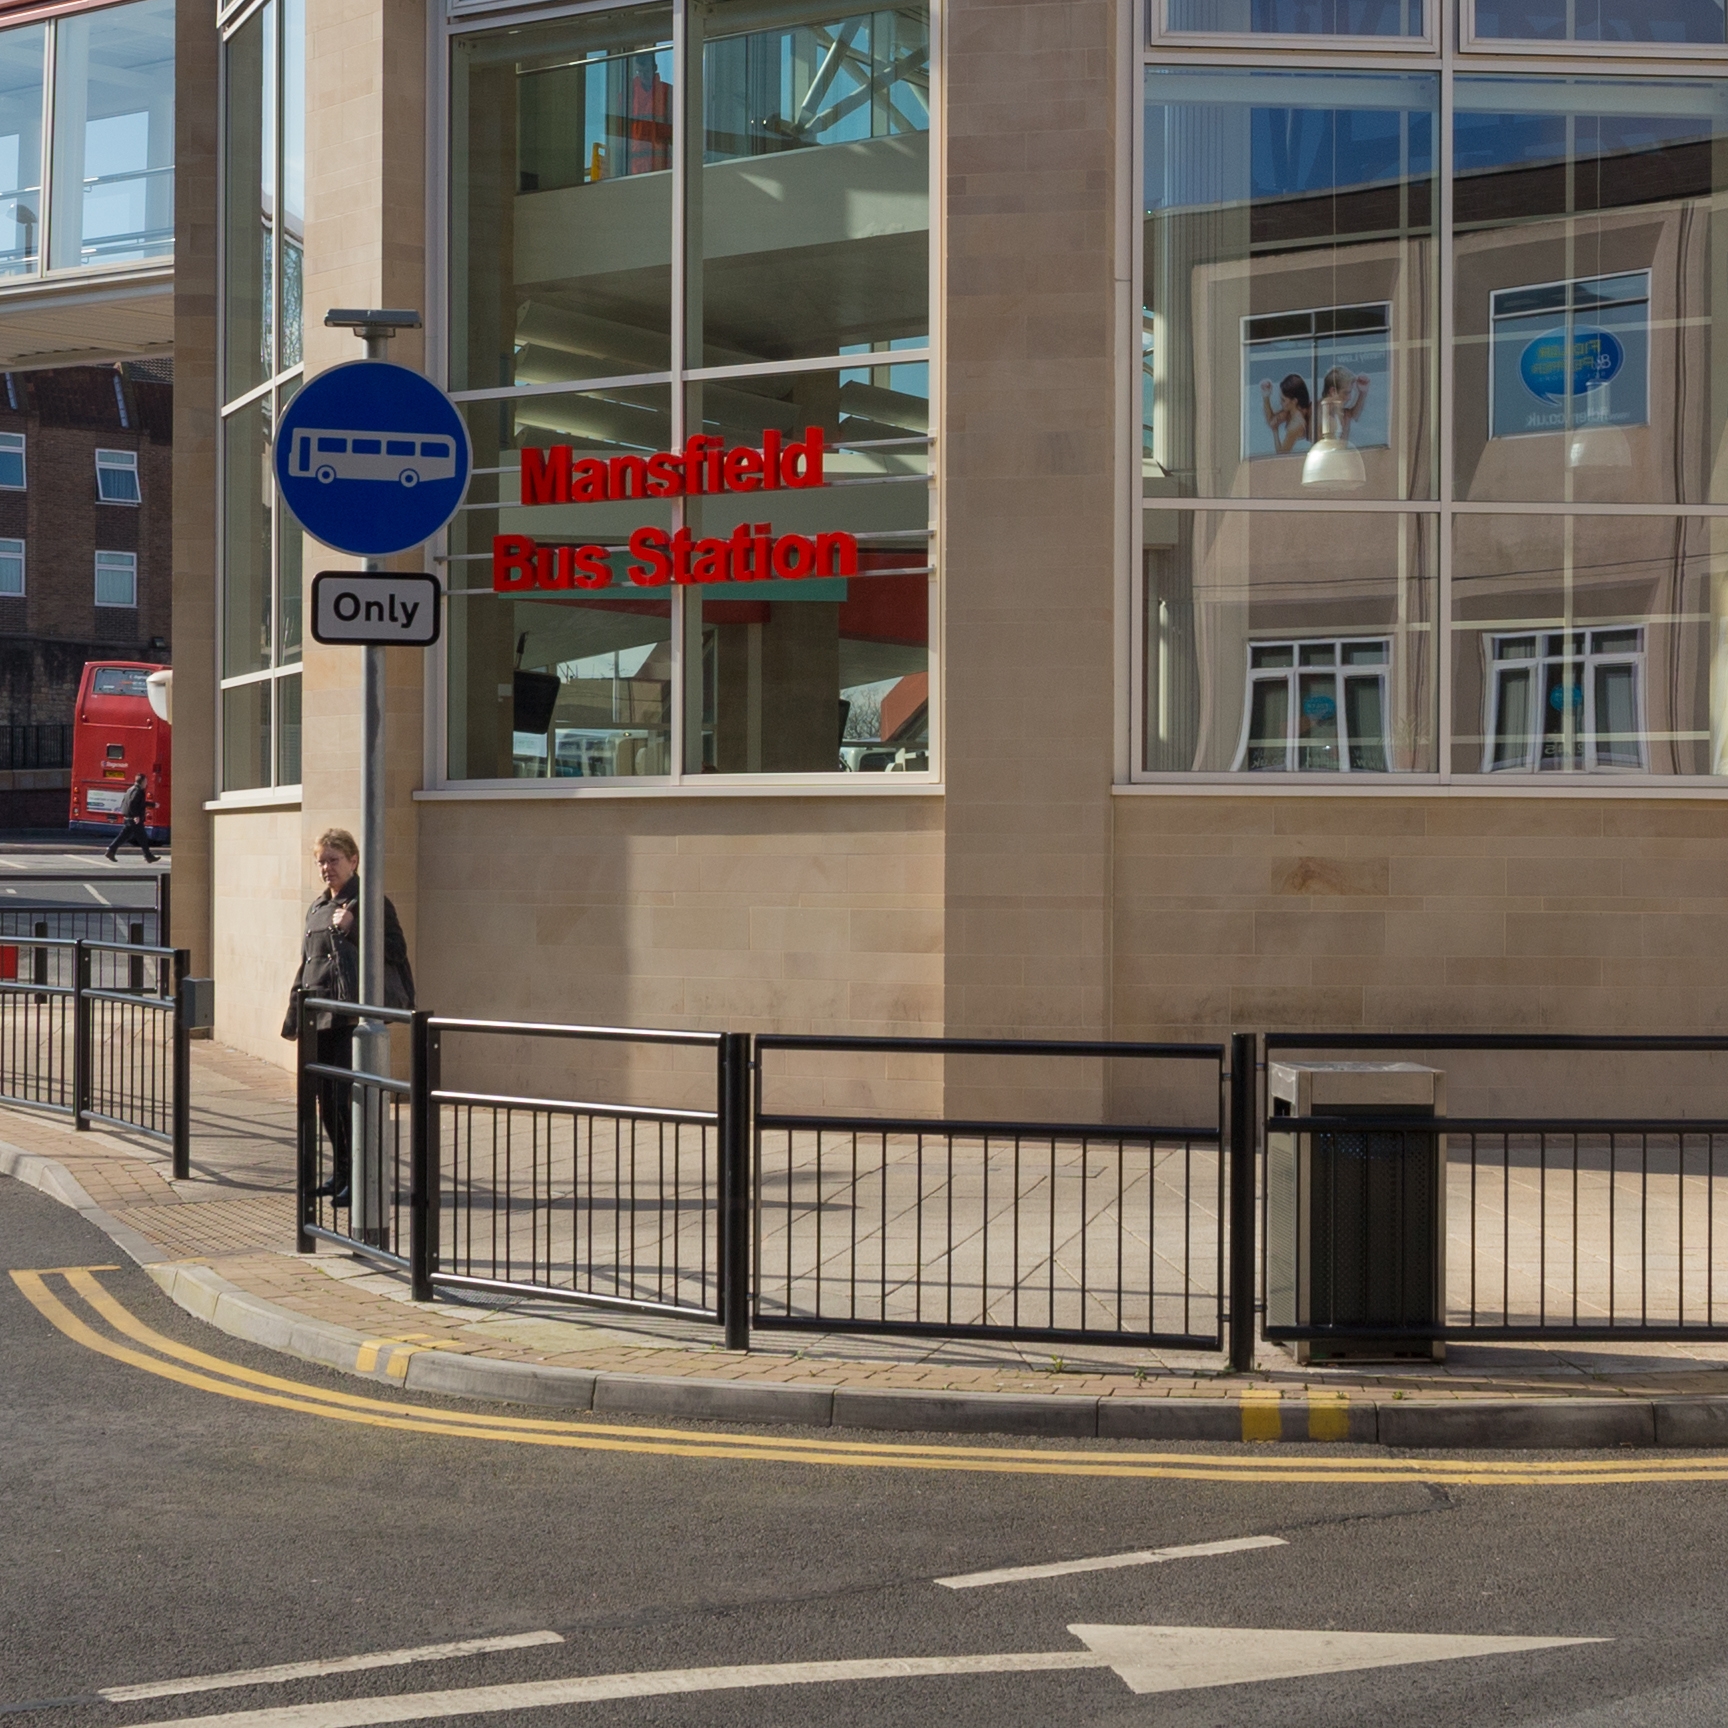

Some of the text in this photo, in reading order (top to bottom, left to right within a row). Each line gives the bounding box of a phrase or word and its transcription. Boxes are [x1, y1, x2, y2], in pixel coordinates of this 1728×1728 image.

[521, 425, 825, 506] Mansfield
[492, 522, 859, 593] Bus Station
[333, 591, 421, 629] Only
